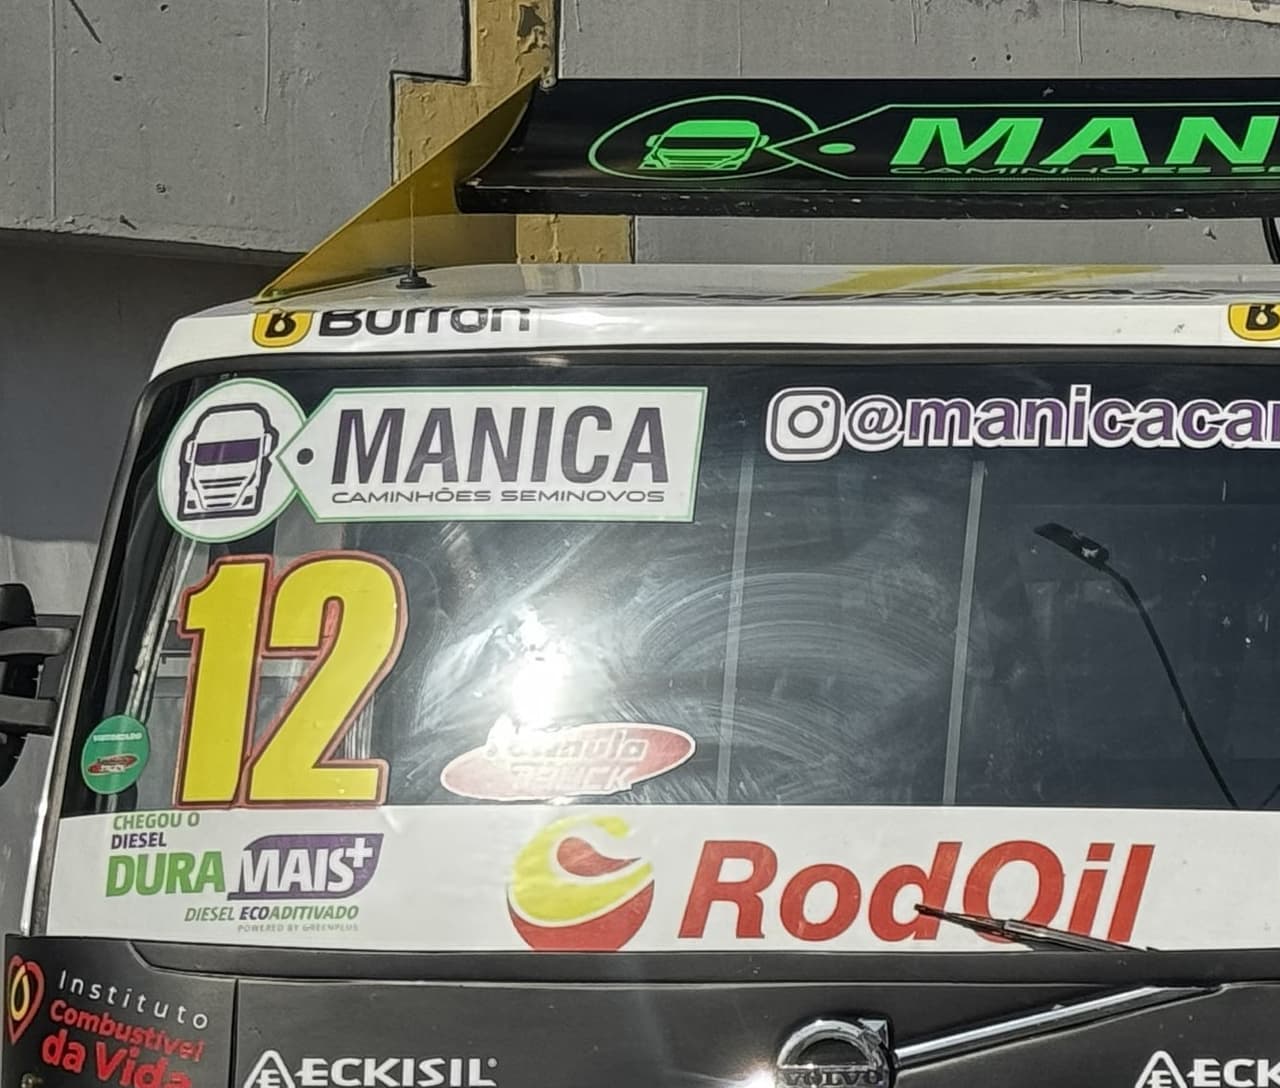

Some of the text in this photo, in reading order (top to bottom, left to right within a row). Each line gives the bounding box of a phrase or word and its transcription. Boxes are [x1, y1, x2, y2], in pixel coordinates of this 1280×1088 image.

[330, 405, 669, 486] MANICA
[330, 488, 666, 504] CAMINHÕES SEMINOVOS
[174, 550, 407, 809] 12
[112, 812, 201, 831] CHEGOU O
[110, 832, 168, 850] DIESEL
[105, 850, 227, 898] DURA
[677, 838, 1156, 945] RodOil
[183, 905, 360, 923] DIESEL ECOADITIVADO
[237, 922, 360, 933] POWERED BY GREENPLUS
[58, 969, 208, 1029] Instituto
[42, 1028, 87, 1074] da
[295, 1057, 498, 1088] ECKISIL
[777, 1069, 882, 1086] VOLVO
